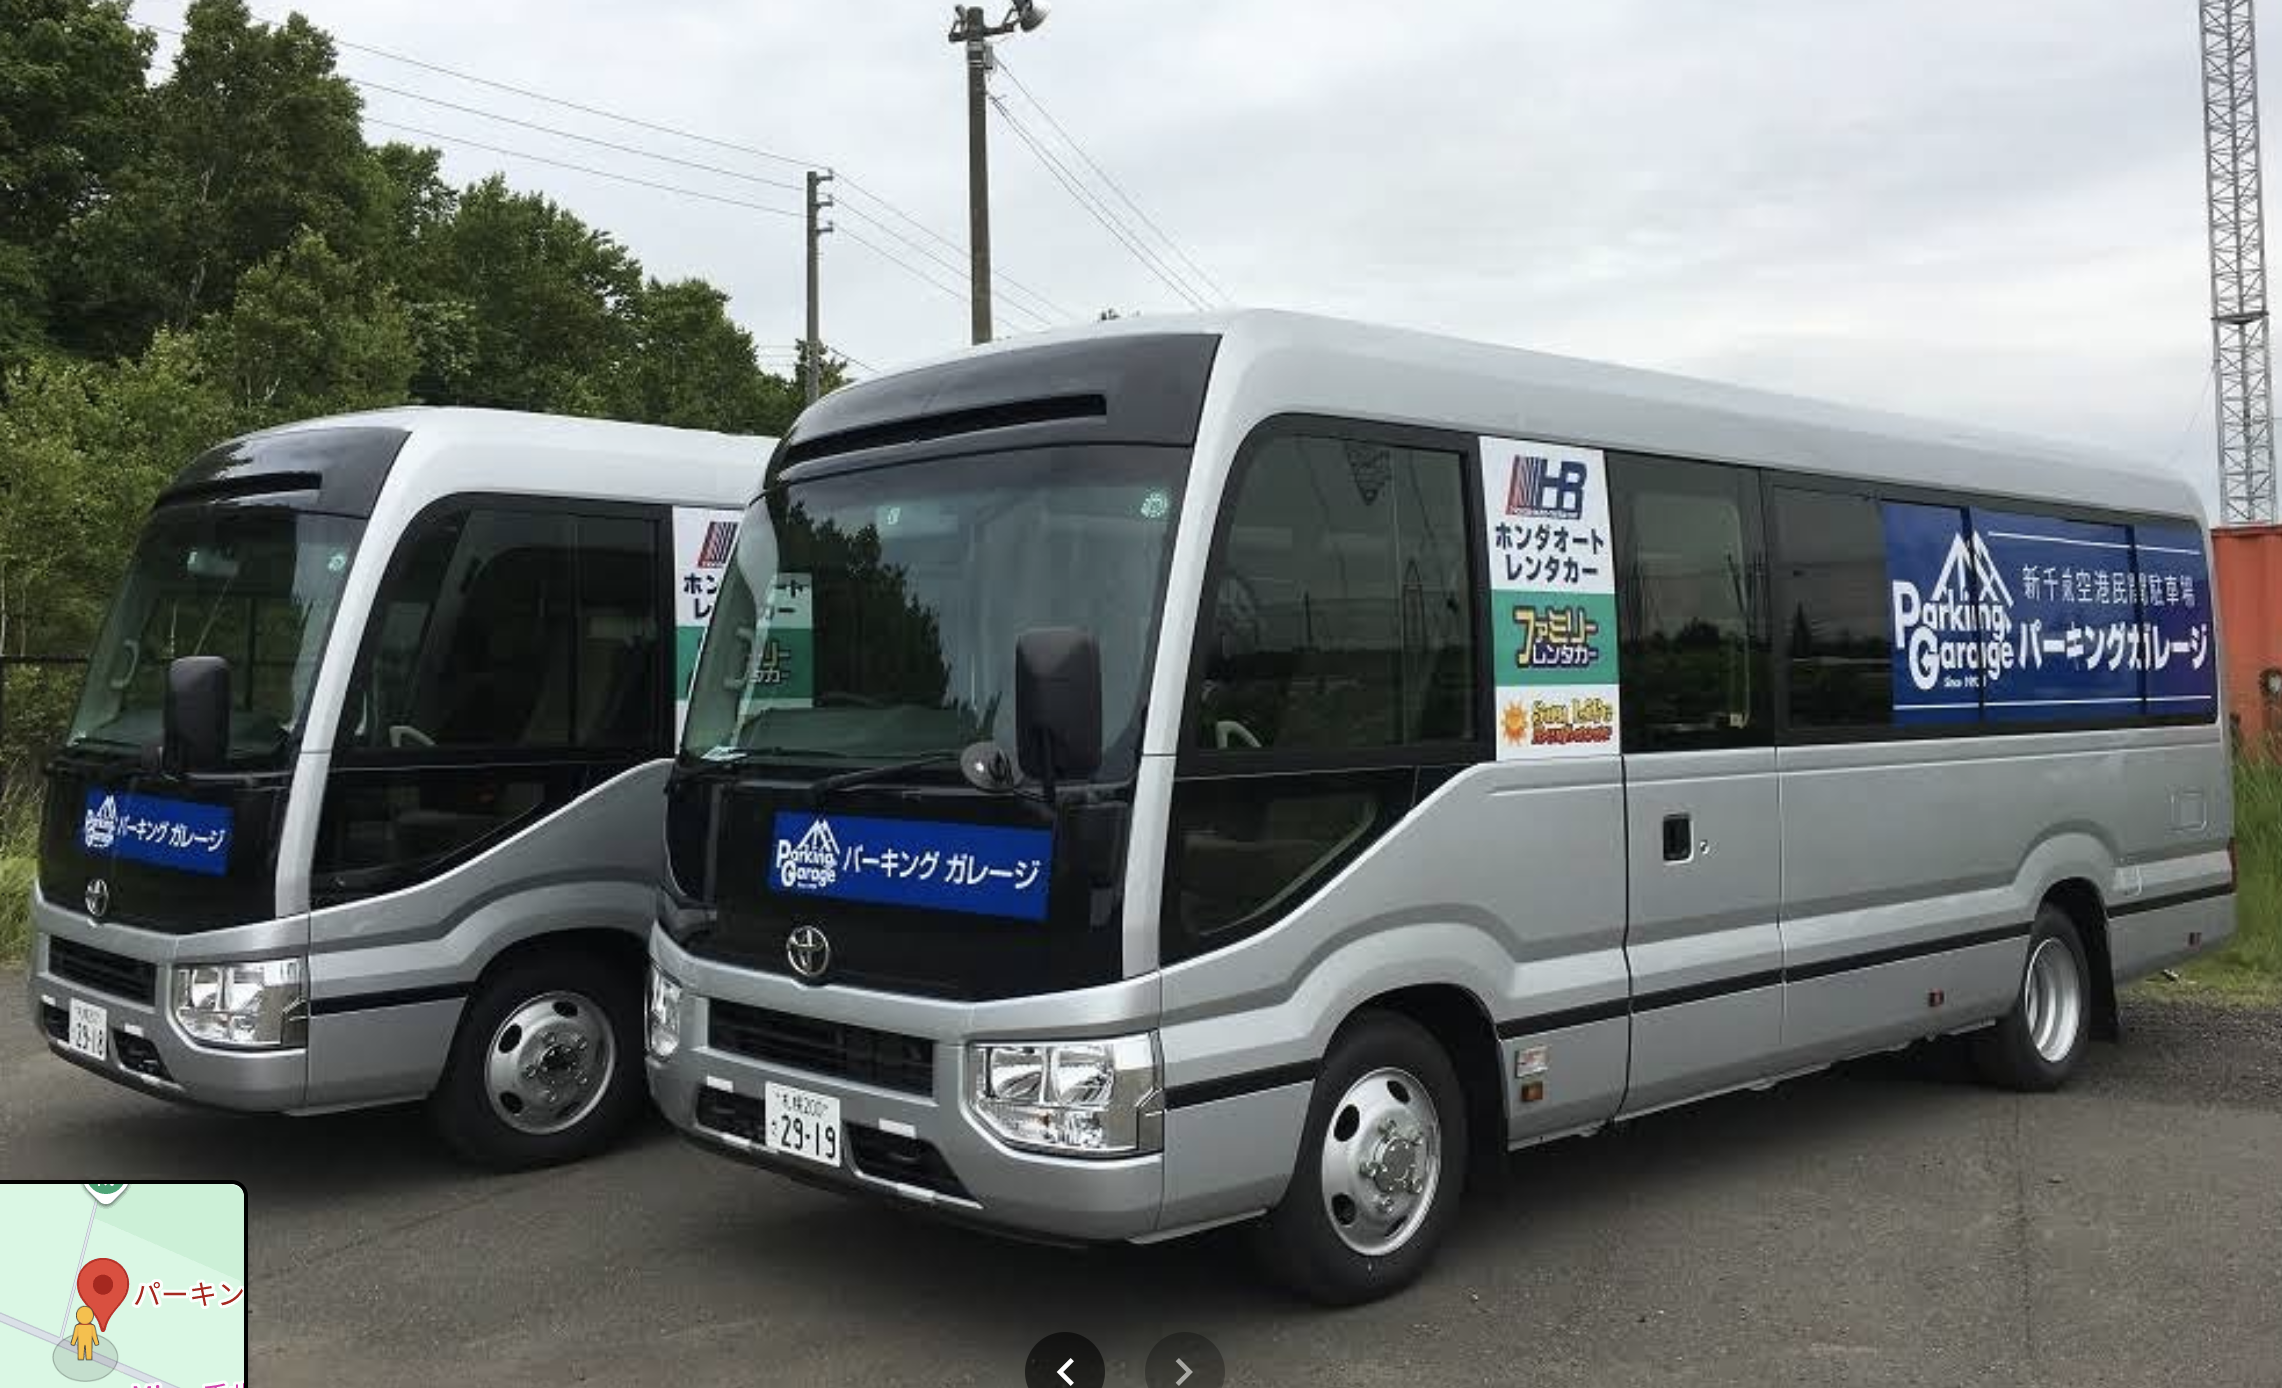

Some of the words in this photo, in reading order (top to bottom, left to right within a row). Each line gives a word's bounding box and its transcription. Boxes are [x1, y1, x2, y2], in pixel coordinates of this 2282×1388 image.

[1495, 523, 1604, 554] ホンダオート
[1506, 554, 1598, 584] レンタカー
[1514, 607, 1598, 667] ファミリー
[1533, 642, 1597, 666] レンタカー
[169, 822, 225, 852] ガレージ
[776, 838, 837, 869] Parking
[781, 860, 837, 888] Garage
[945, 853, 1041, 890] ガレージ
